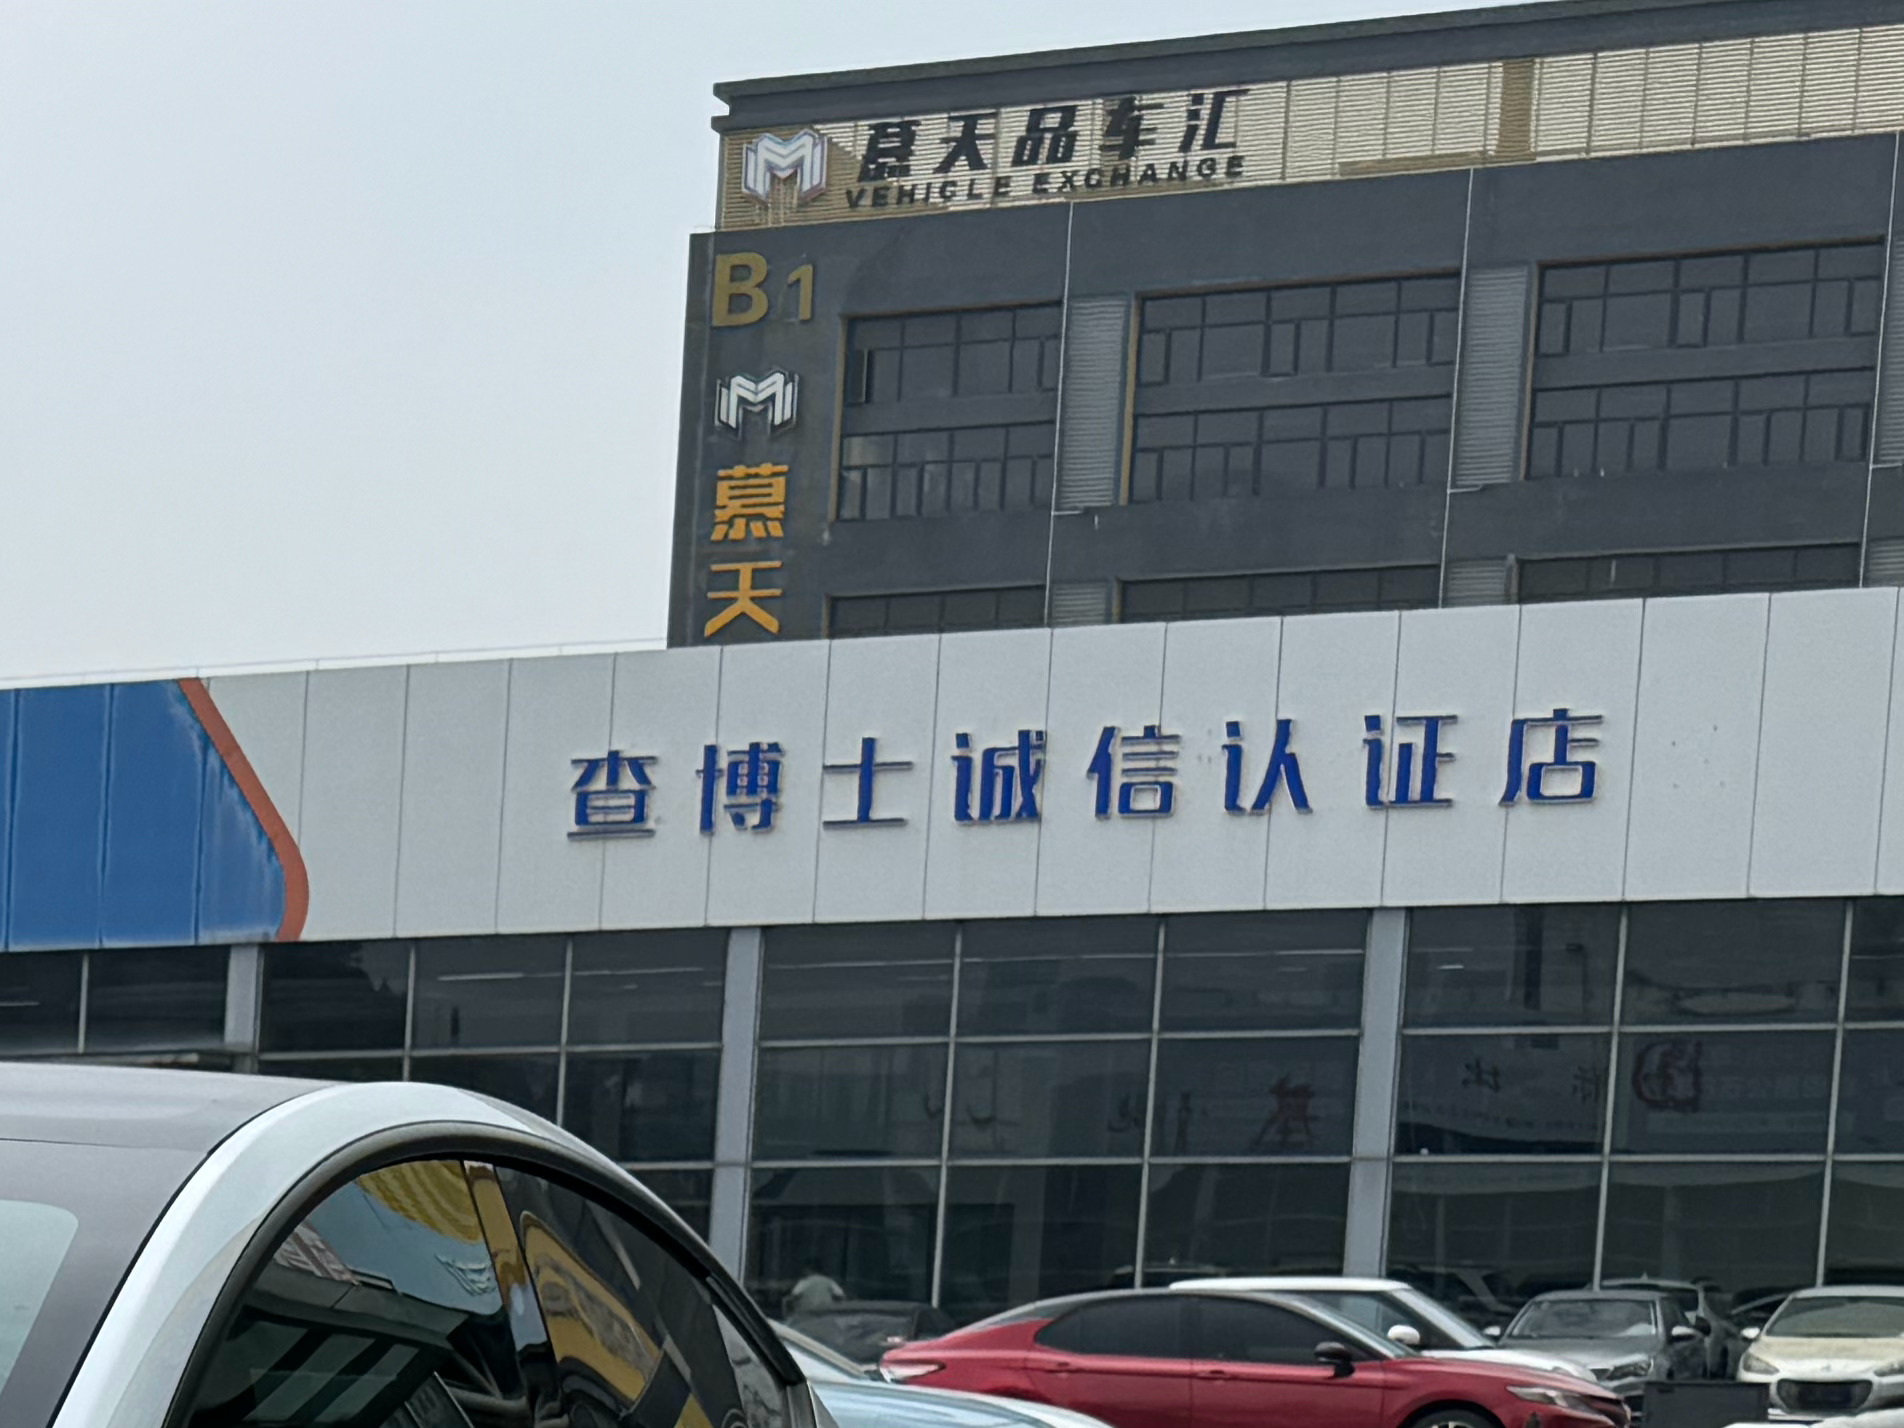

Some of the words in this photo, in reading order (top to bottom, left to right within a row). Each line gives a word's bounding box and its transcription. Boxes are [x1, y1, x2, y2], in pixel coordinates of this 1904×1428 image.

[1031, 155, 1245, 195] EXCHANGE
[711, 251, 815, 328] B1
[704, 462, 790, 638] 慕天
[566, 707, 1604, 839] 查博士诚信认证店
